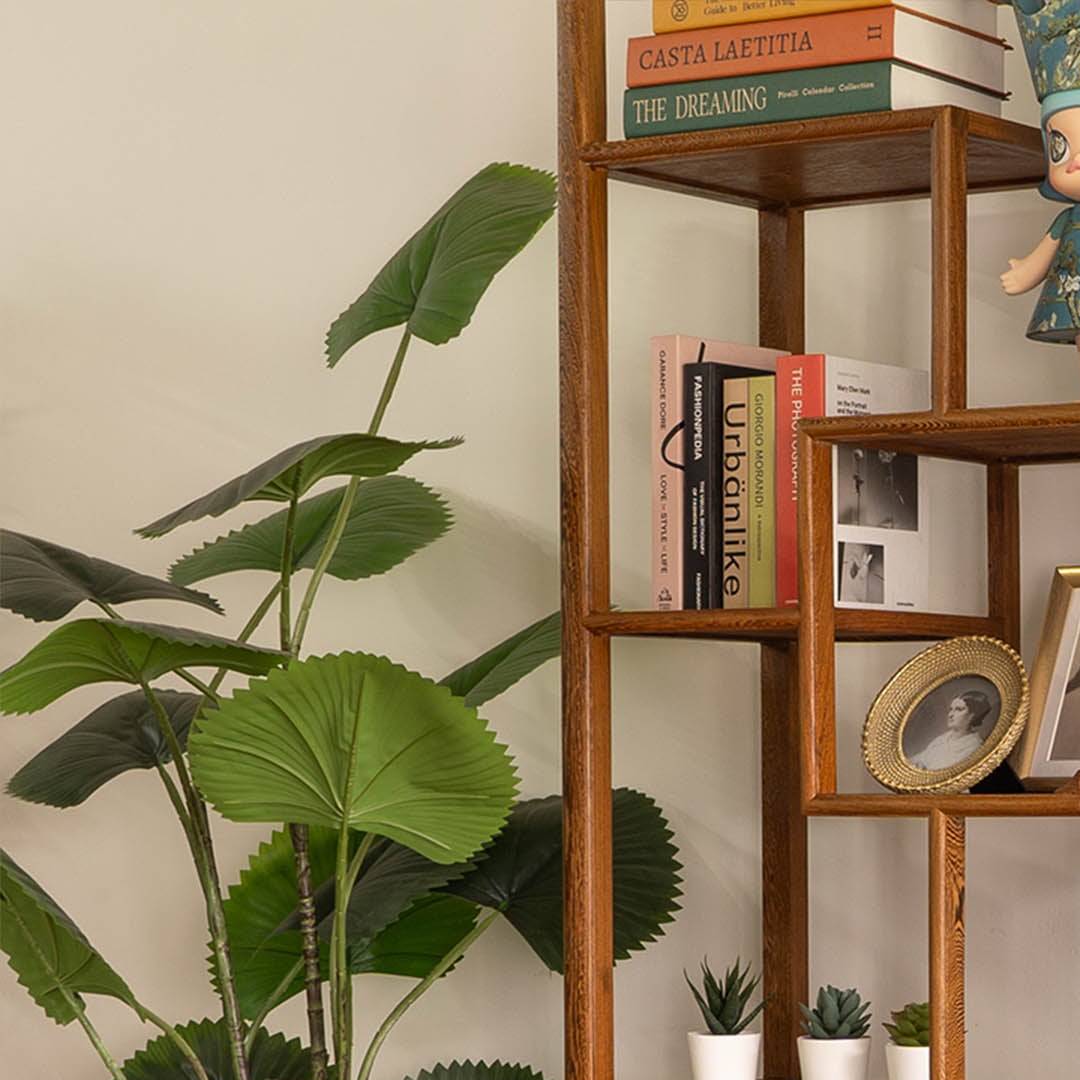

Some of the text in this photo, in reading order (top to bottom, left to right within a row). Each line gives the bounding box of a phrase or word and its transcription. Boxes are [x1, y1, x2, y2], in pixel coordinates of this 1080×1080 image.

[639, 30, 813, 71] CASTA LAETITIA
[633, 86, 767, 125] THE DREAMING
[694, 375, 703, 460] FASHIONPEDIA
[791, 368, 803, 397] THE
[755, 393, 764, 508] GIORGIO MORANDI
[660, 474, 668, 573] LOVE STYLE LIFE
[724, 403, 747, 595] Urbänlike
